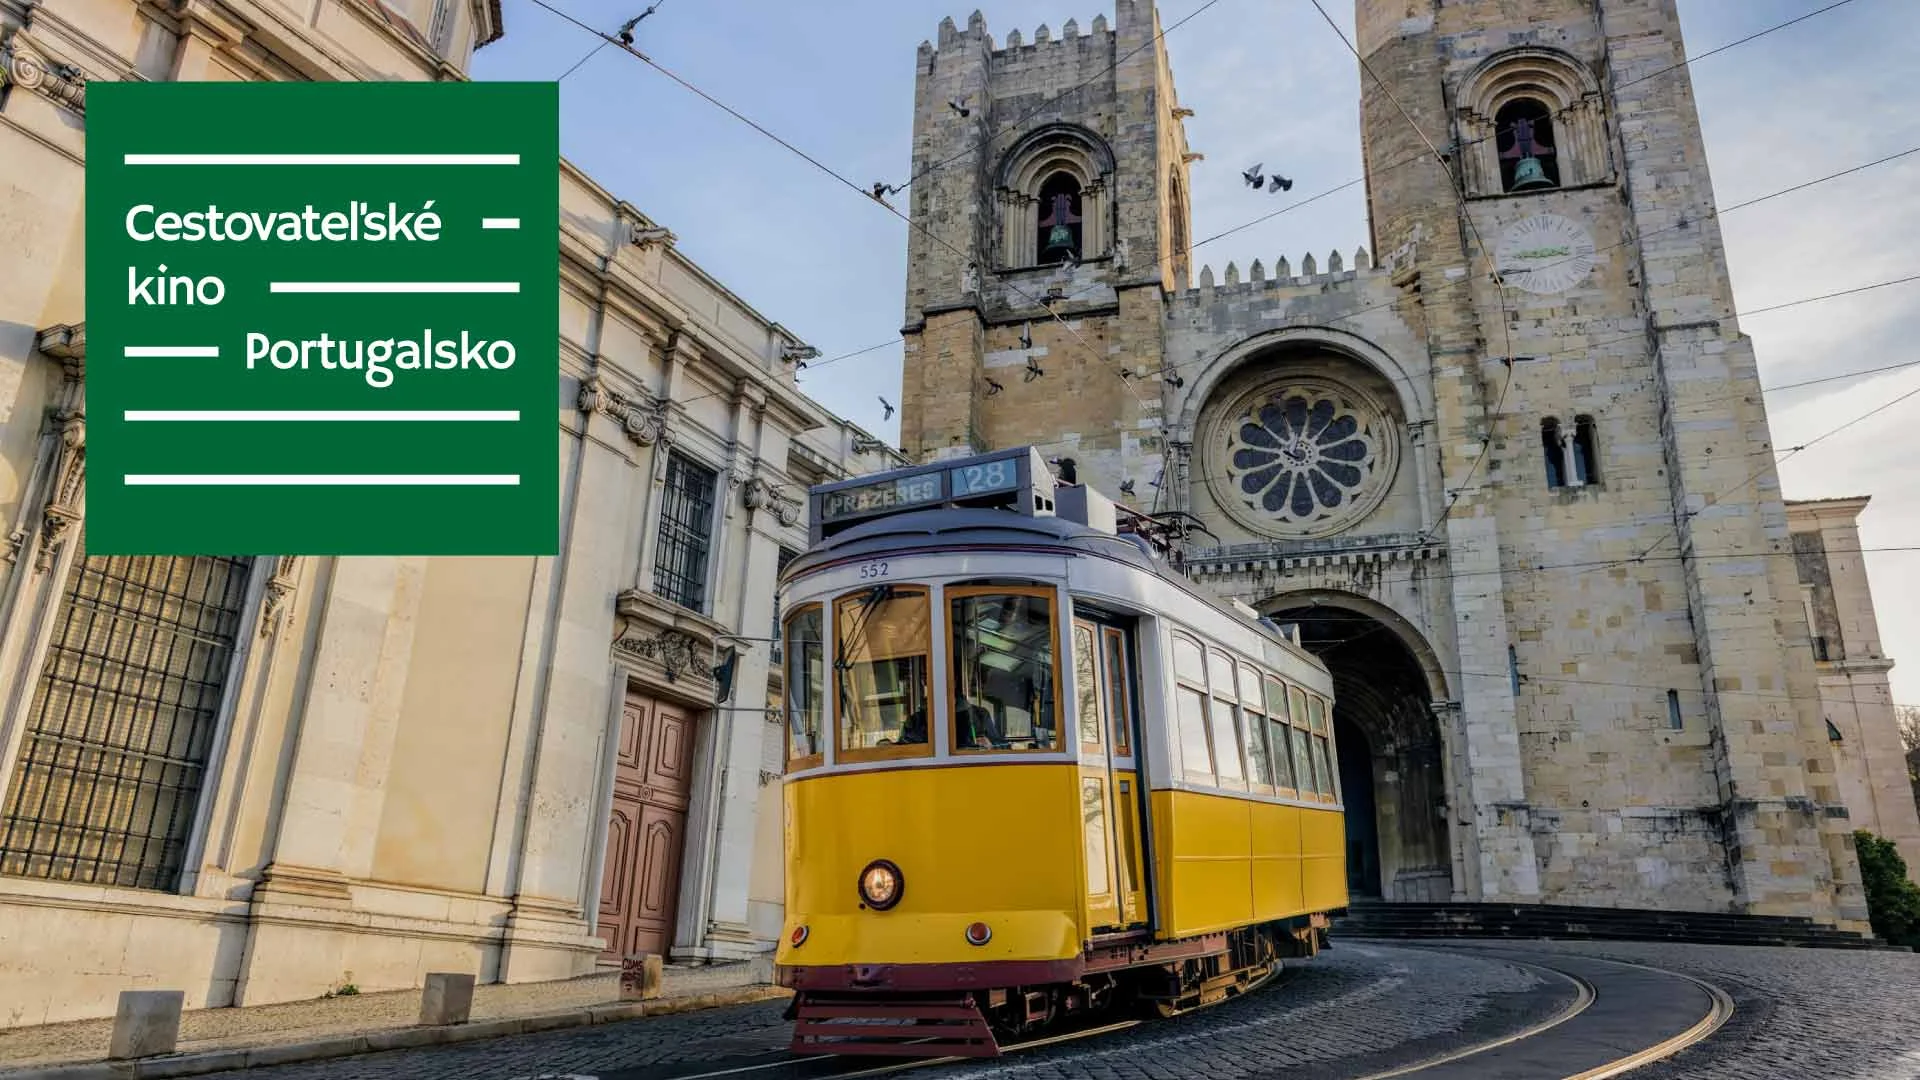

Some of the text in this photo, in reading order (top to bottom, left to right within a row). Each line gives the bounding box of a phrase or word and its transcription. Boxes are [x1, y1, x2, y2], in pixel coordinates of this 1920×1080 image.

[967, 462, 1006, 491] 28
[831, 481, 934, 516] PRAZERES
[860, 562, 889, 579] 552
